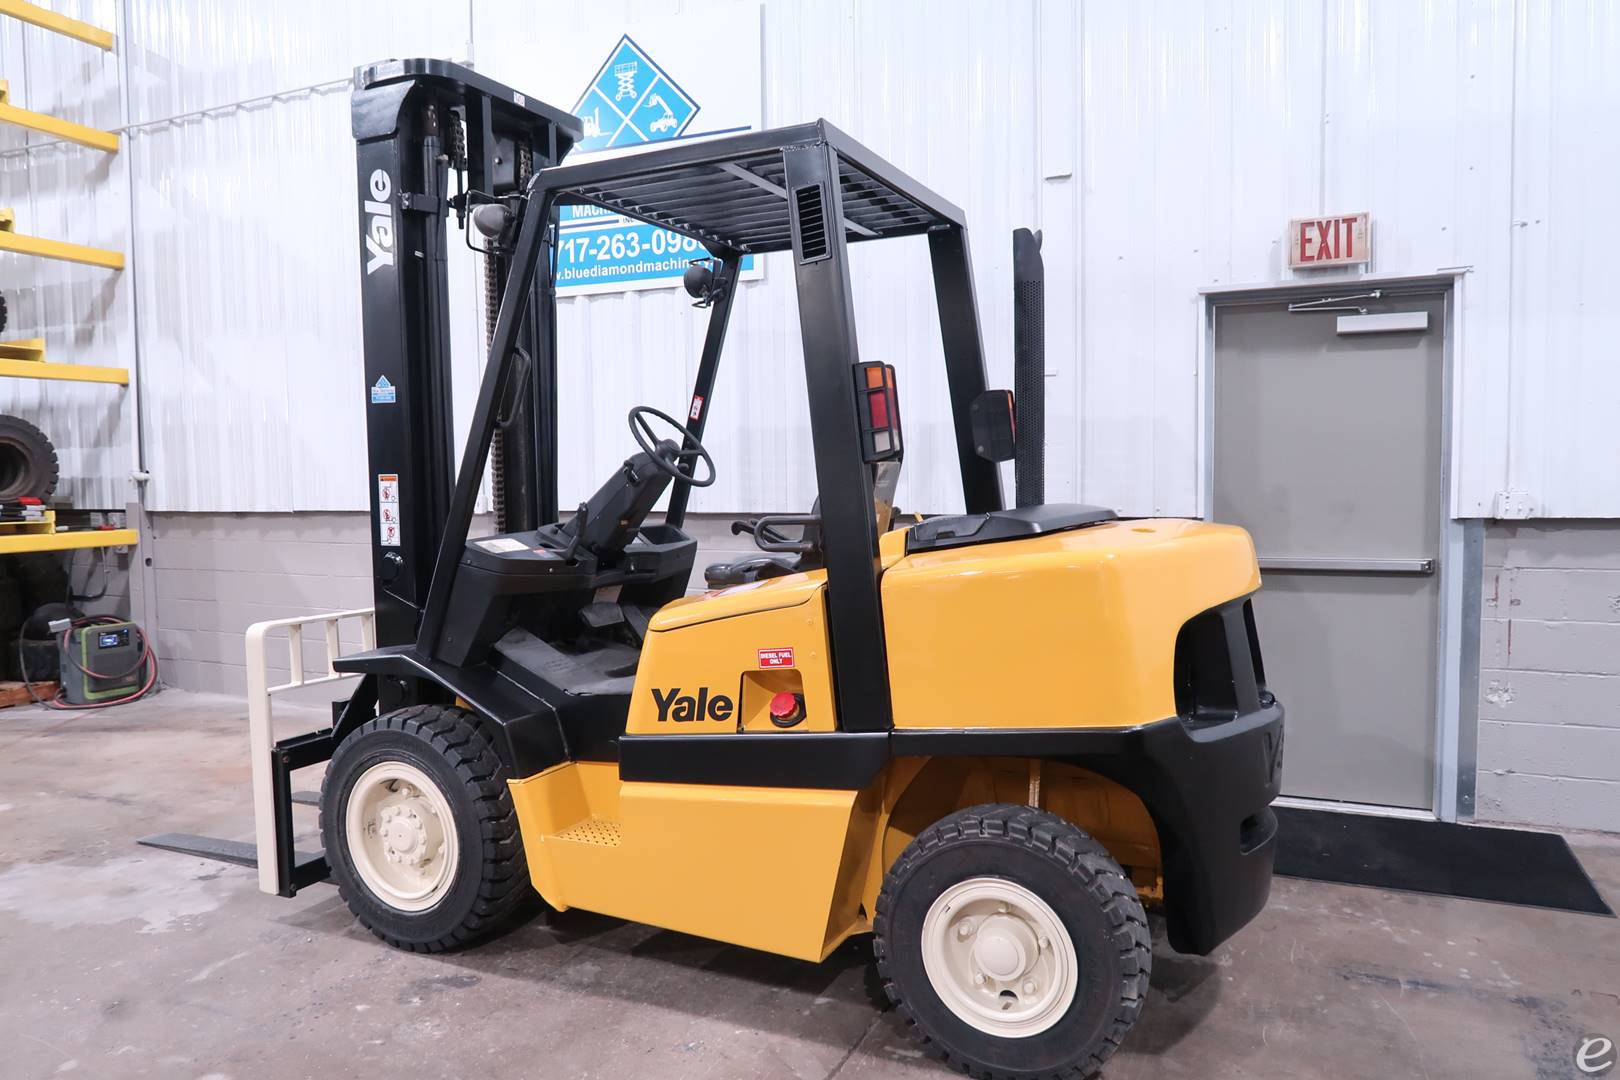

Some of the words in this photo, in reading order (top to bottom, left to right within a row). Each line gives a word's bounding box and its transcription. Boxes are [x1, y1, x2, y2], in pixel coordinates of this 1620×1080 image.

[364, 169, 393, 275] Yale
[1300, 217, 1357, 262] EXIT
[651, 687, 734, 722] Yale
